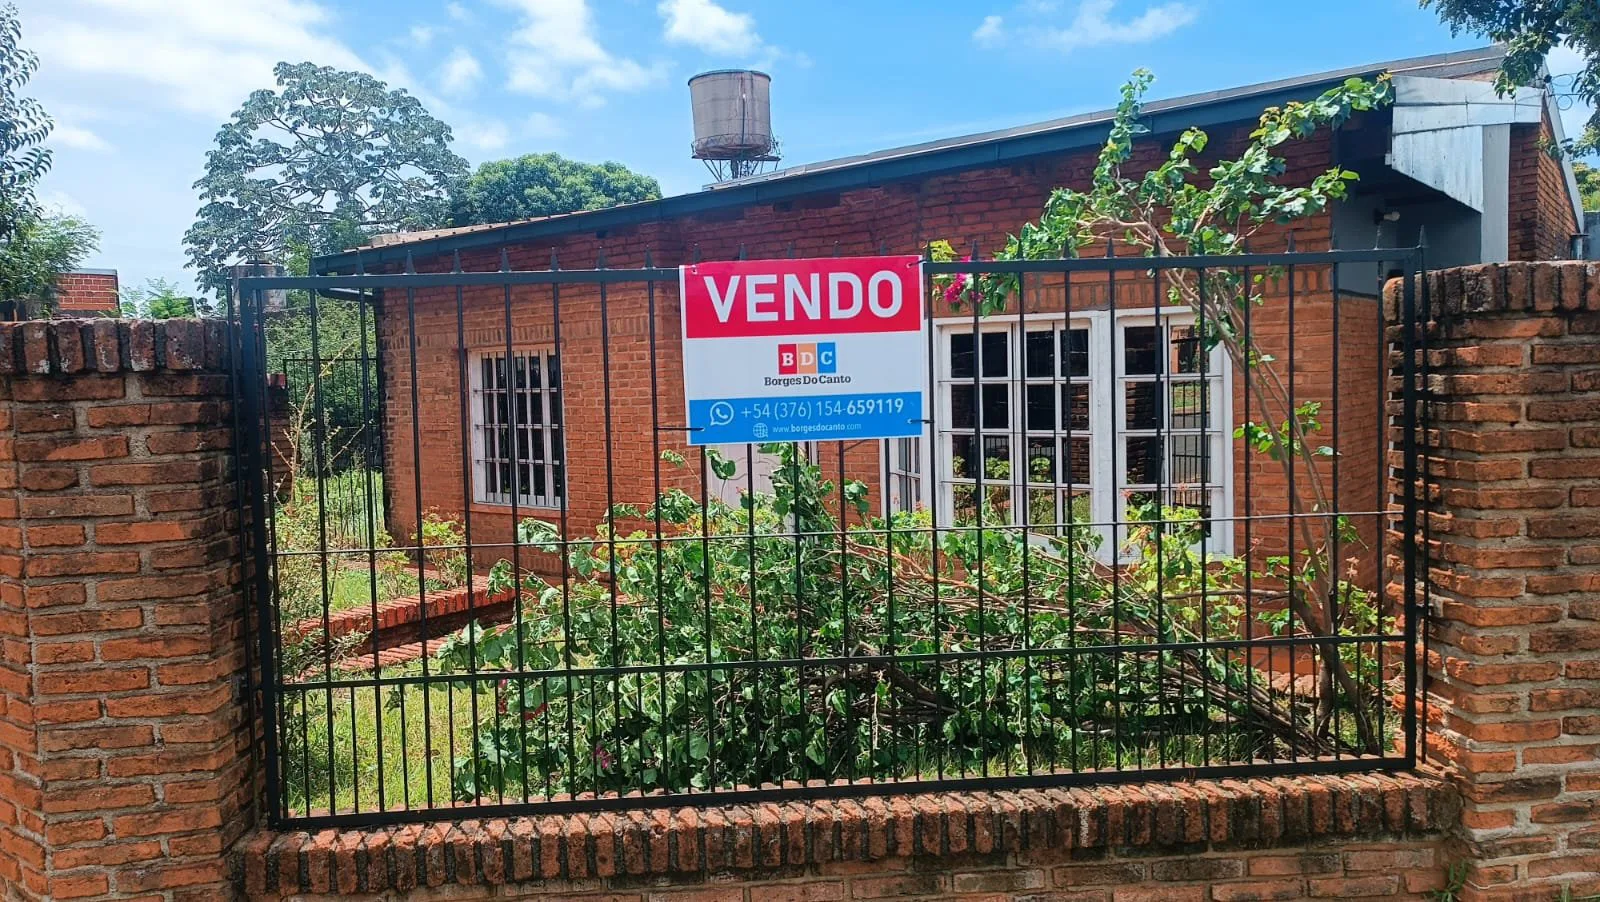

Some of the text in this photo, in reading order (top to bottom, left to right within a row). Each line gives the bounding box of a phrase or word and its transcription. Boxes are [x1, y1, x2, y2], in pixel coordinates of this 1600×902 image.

[703, 270, 903, 323] VENDO
[764, 375, 851, 387] Borges Do Canto
[741, 398, 904, 420] +54 (376) 154-659119
[772, 422, 862, 434] www.borgesdocanto.com
